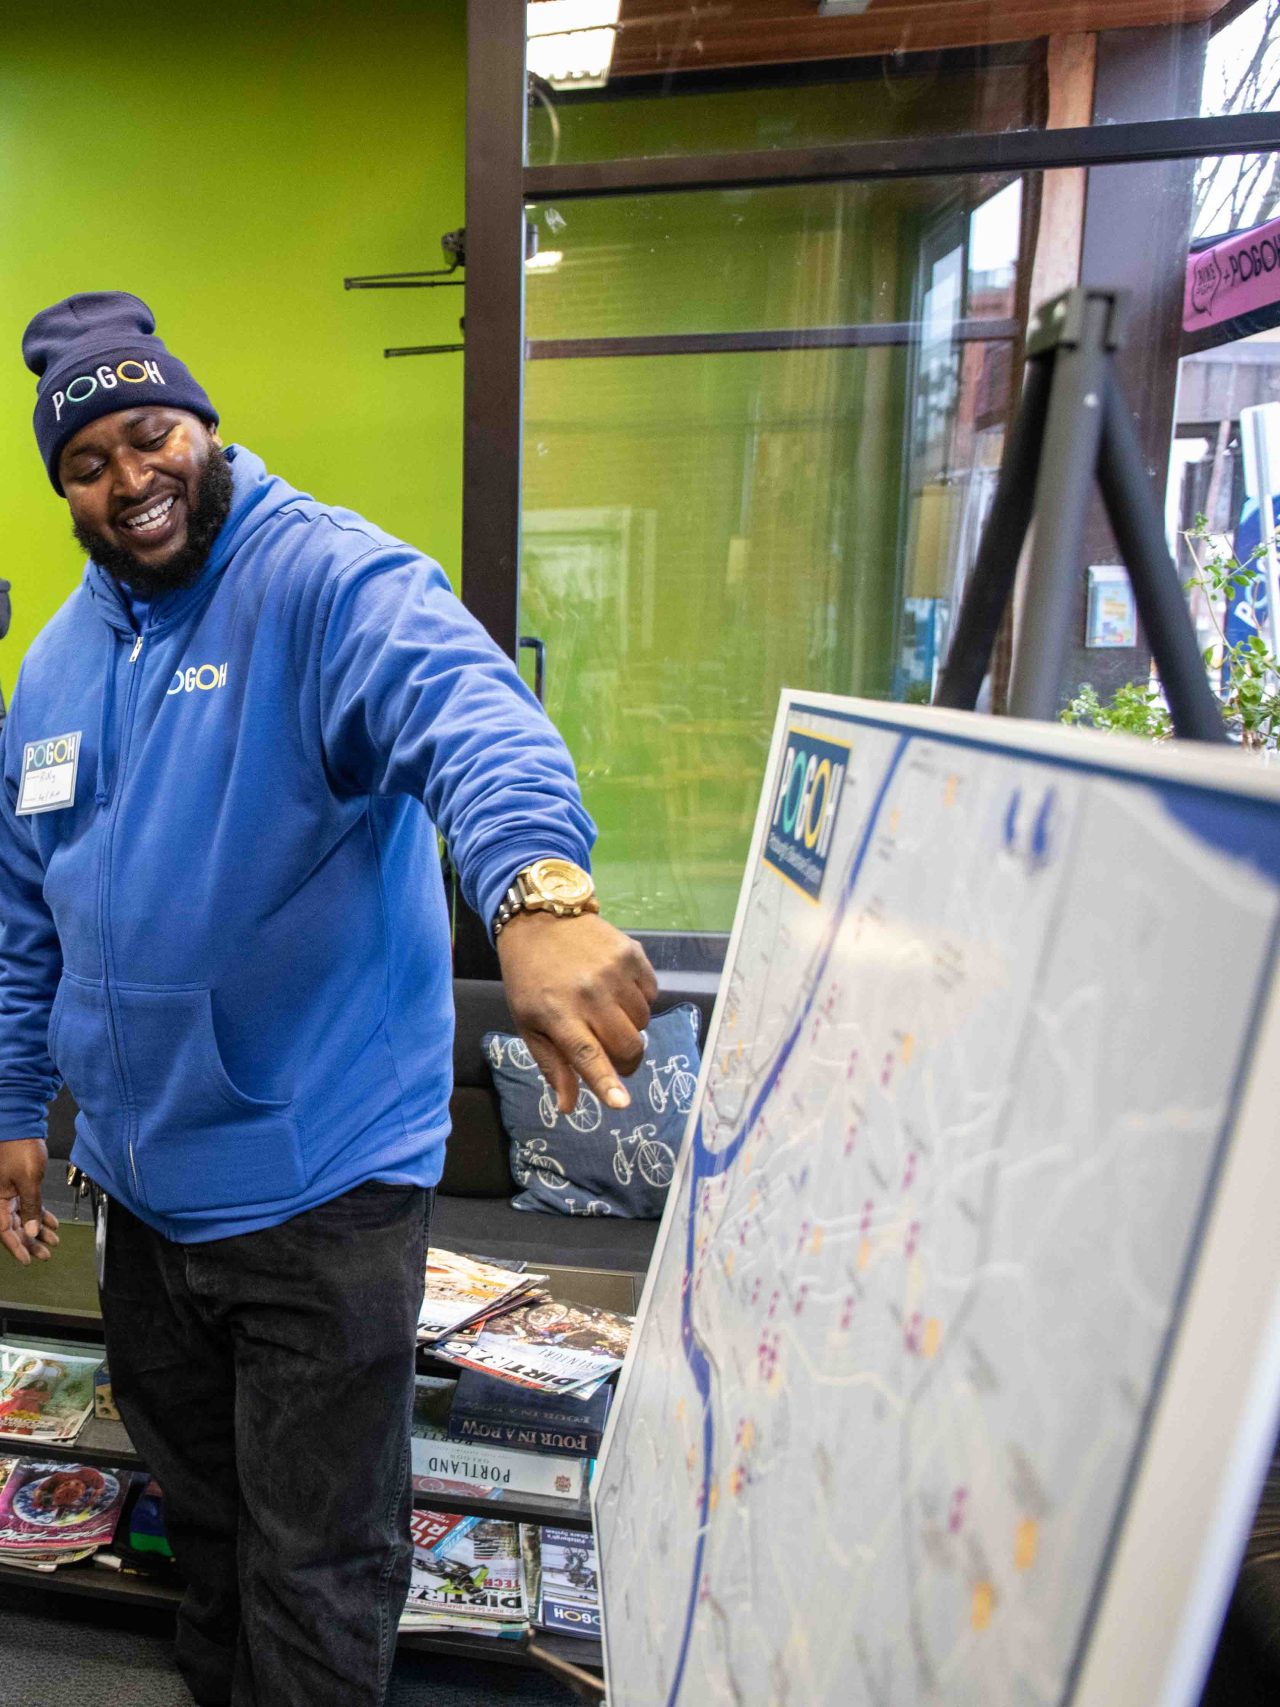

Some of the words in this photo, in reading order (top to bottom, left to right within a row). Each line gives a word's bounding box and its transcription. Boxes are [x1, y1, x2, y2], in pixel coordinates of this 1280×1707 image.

[52, 360, 166, 421] POGOH
[166, 662, 229, 696] OGOH
[26, 737, 76, 770] POGOH
[772, 747, 845, 858] POGOH
[506, 1363, 580, 1387] DIRT
[462, 1419, 503, 1439] ROW
[506, 1428, 518, 1440] A
[520, 1430, 537, 1444] IN
[541, 1432, 589, 1451] FOUR
[428, 1456, 511, 1483] PORTLAND
[483, 1576, 520, 1589] TECH
